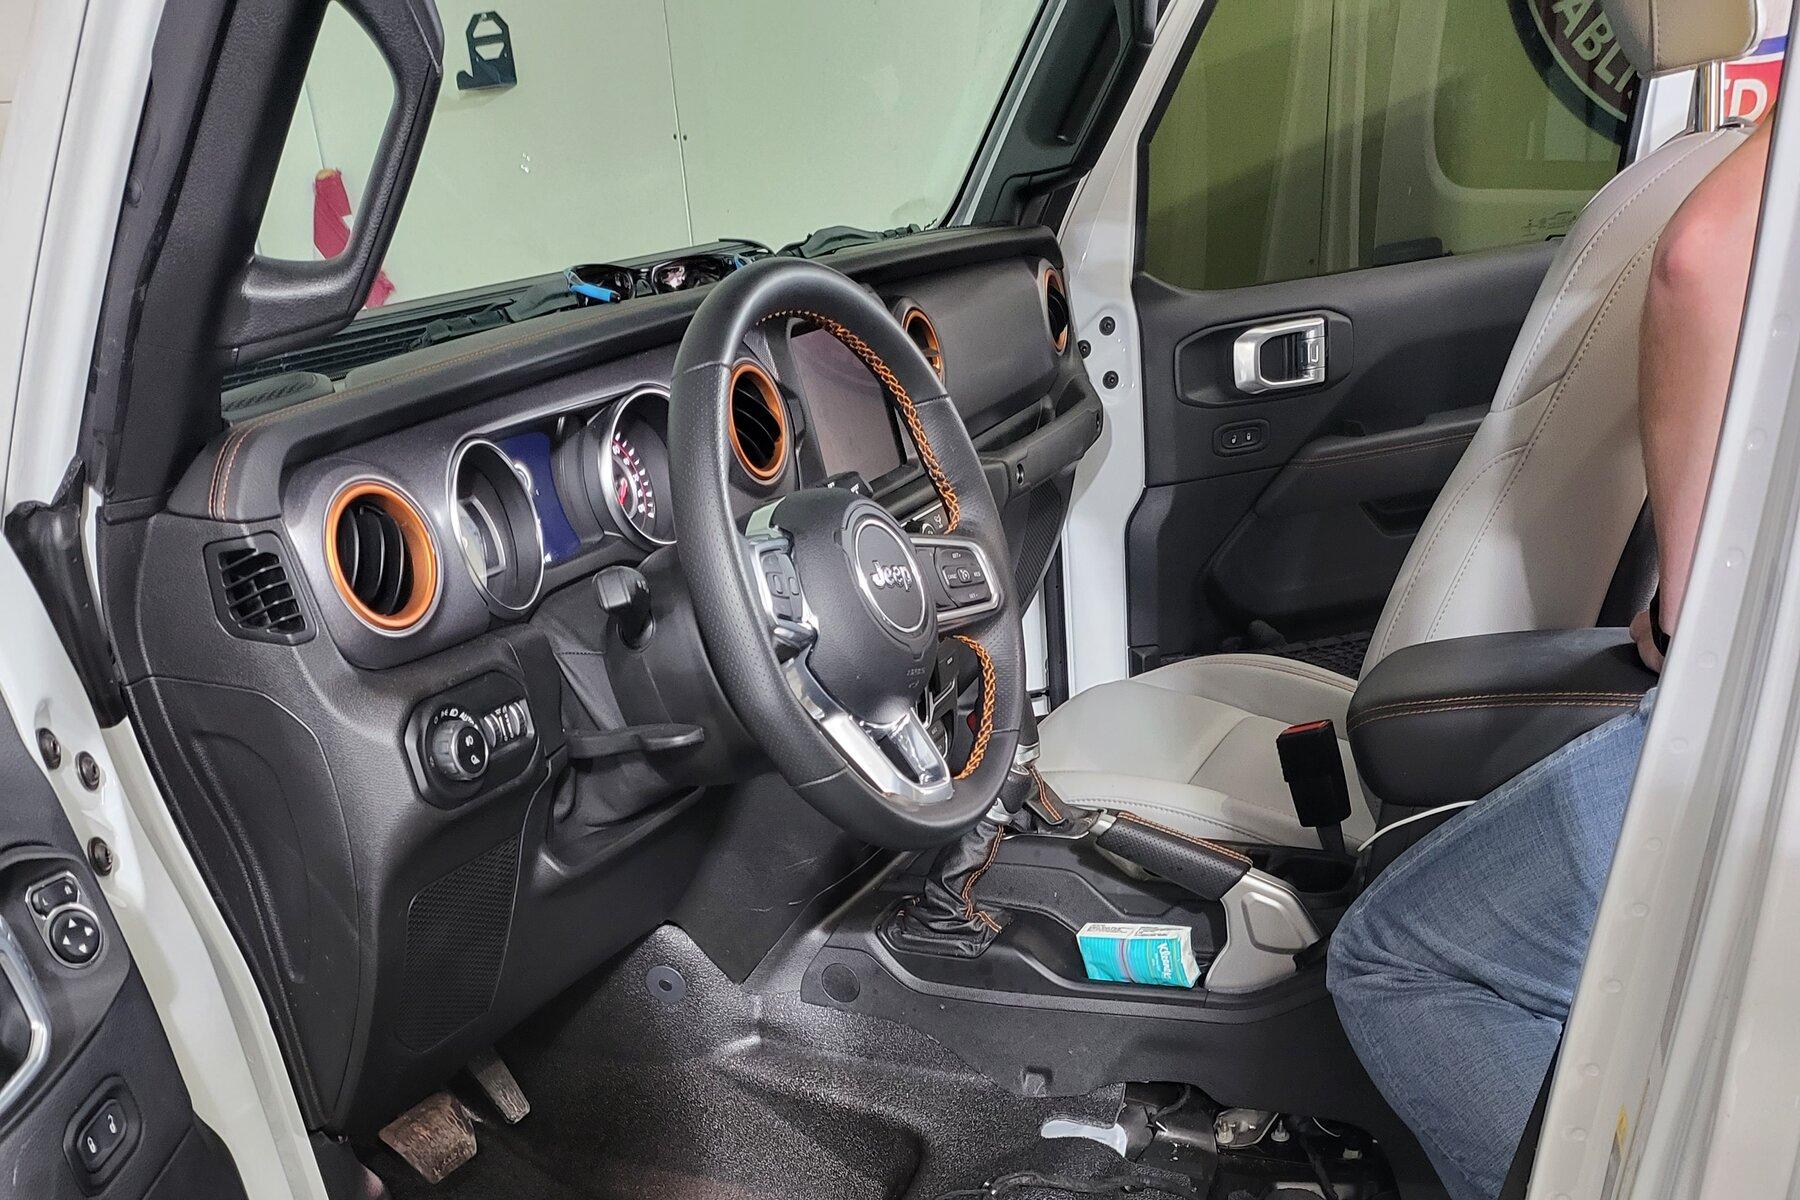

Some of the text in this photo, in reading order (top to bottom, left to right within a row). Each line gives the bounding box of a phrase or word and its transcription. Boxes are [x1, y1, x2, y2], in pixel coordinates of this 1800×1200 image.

[1551, 0, 1637, 100] ABLI
[1724, 78, 1768, 122] D
[870, 560, 912, 592] Jeep
